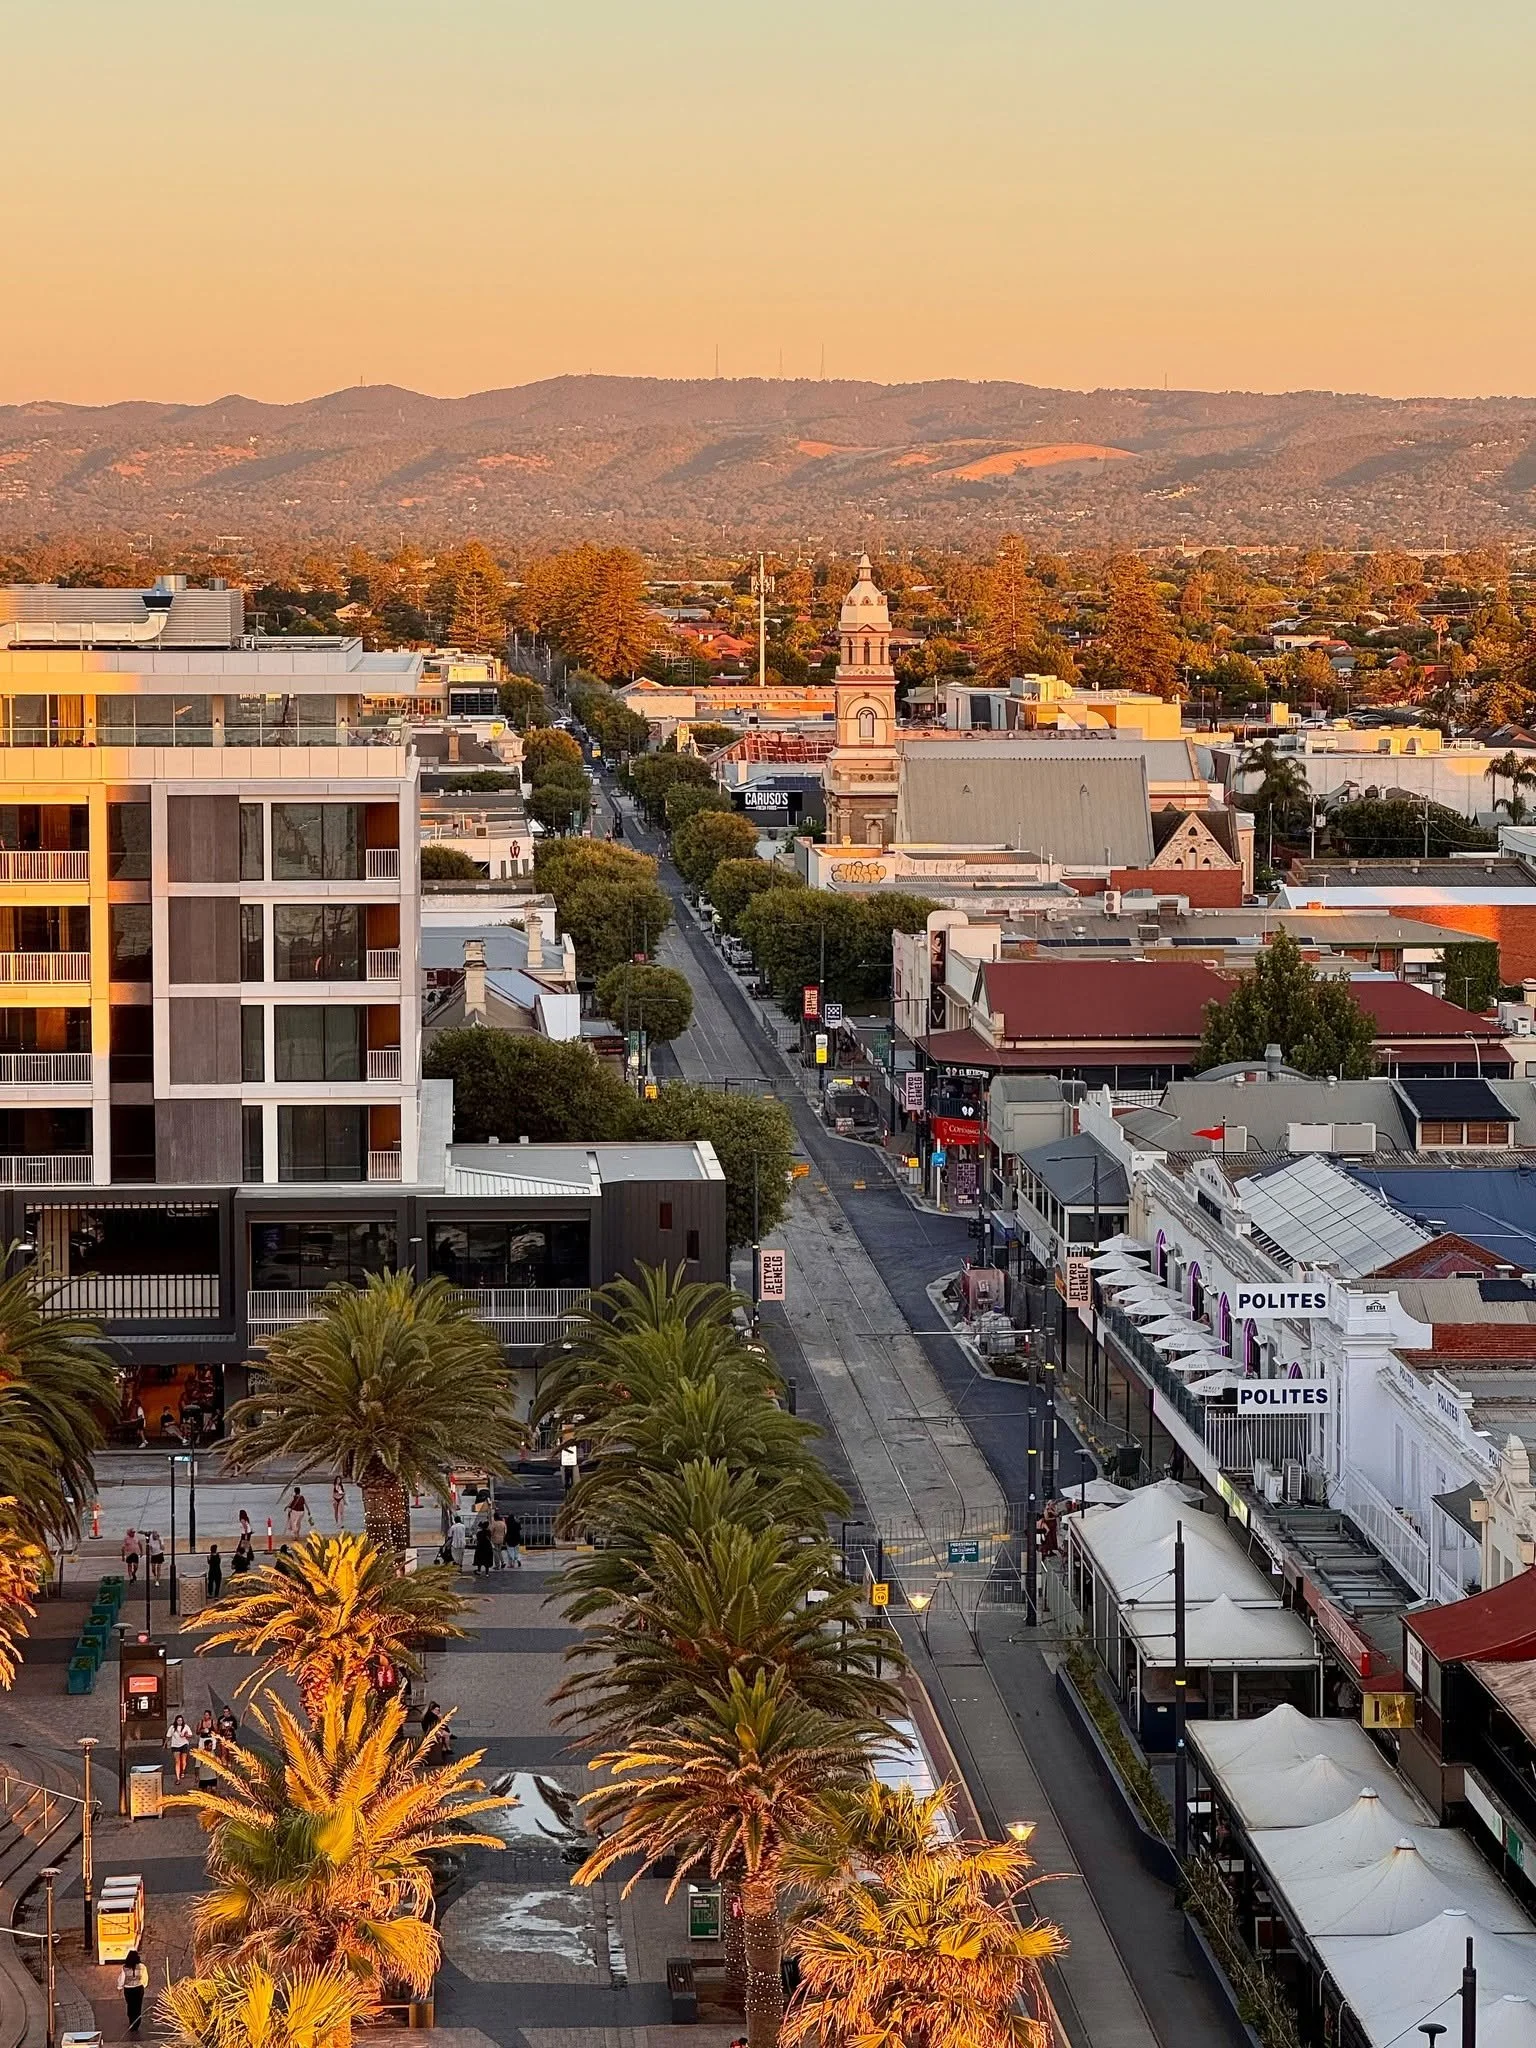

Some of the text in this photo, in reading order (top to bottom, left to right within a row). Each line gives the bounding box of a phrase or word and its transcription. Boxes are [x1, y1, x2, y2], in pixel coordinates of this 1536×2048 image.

[745, 792, 788, 805] CARUSO'S
[772, 1256, 782, 1294] GLENELG
[1239, 1293, 1326, 1309] POLITES
[1240, 1388, 1328, 1405] POLITES
[1438, 1392, 1458, 1422] POLITES
